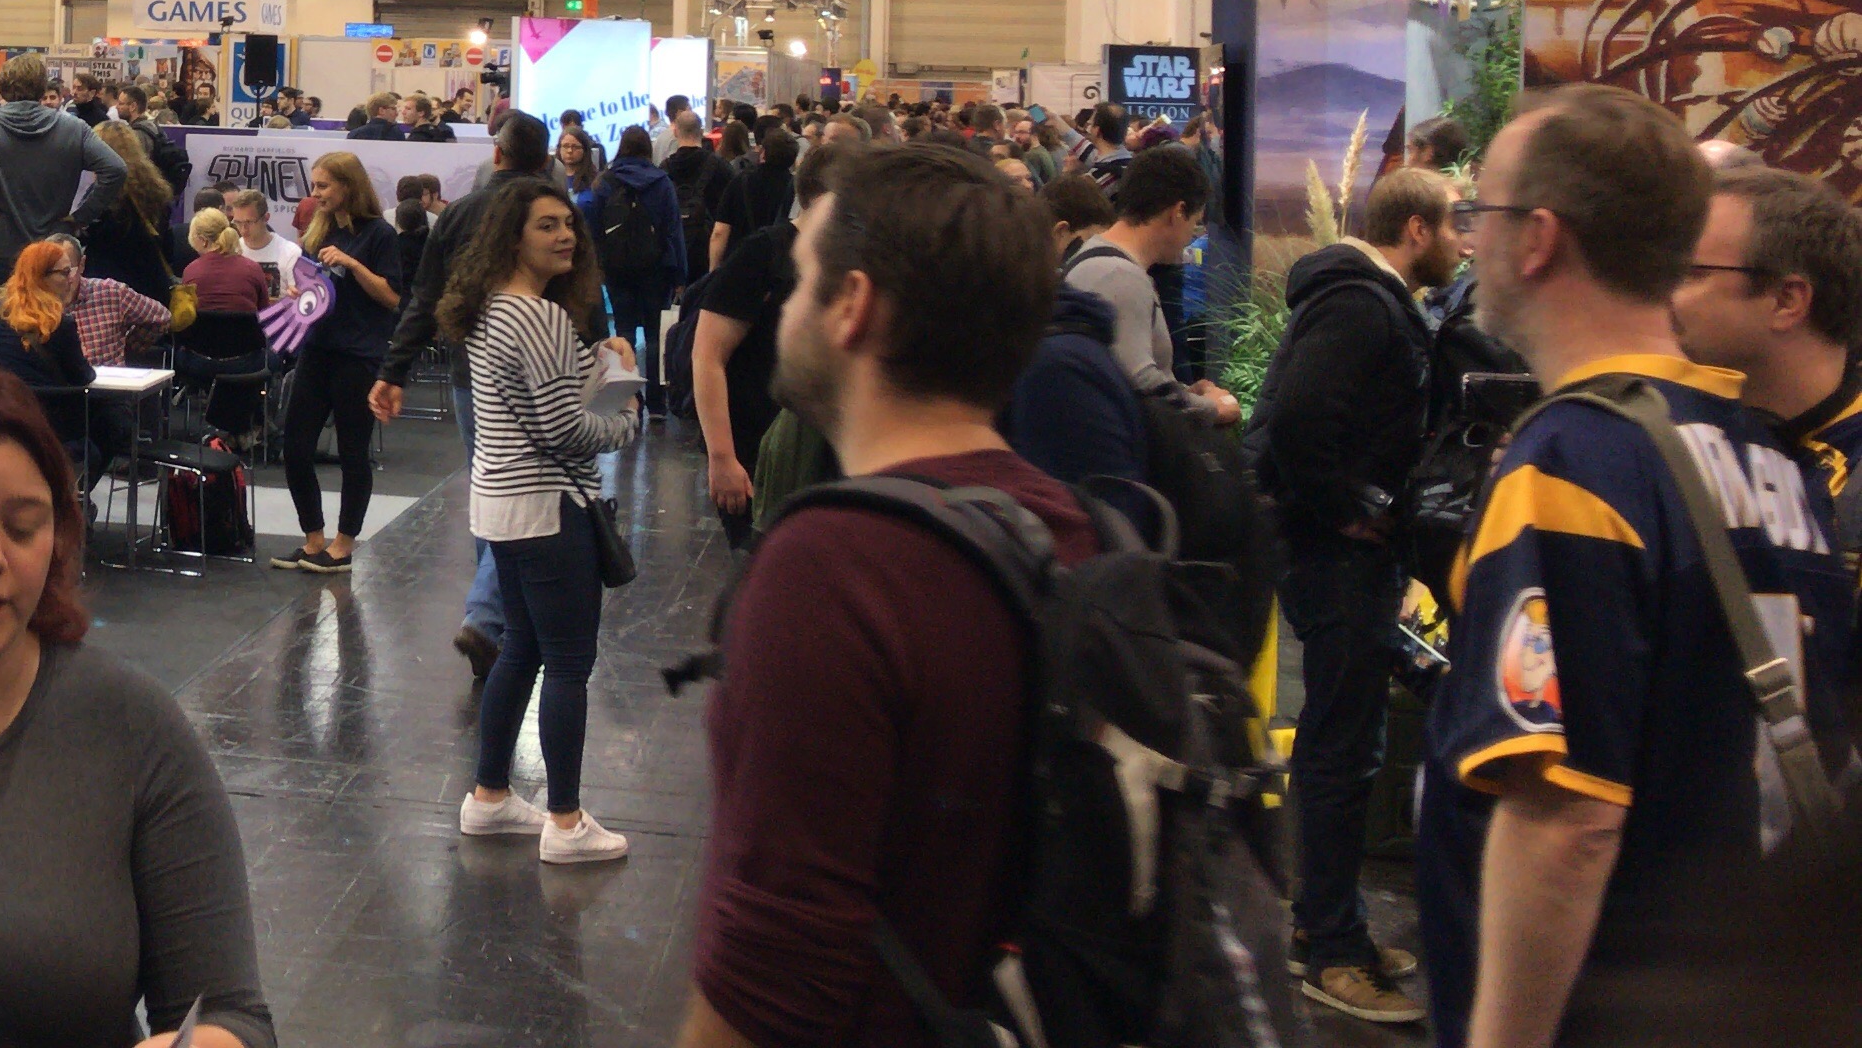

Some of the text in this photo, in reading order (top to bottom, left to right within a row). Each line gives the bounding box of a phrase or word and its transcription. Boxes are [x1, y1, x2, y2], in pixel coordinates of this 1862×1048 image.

[147, 1, 248, 23] GAMES
[92, 62, 117, 70] STEAL
[92, 70, 111, 78] THIS
[1123, 54, 1196, 77] STAR
[1123, 77, 1196, 99] WARS
[599, 101, 618, 117] to
[621, 91, 651, 110] the
[1127, 106, 1191, 120] LEGION
[207, 154, 312, 203] SPYNET
